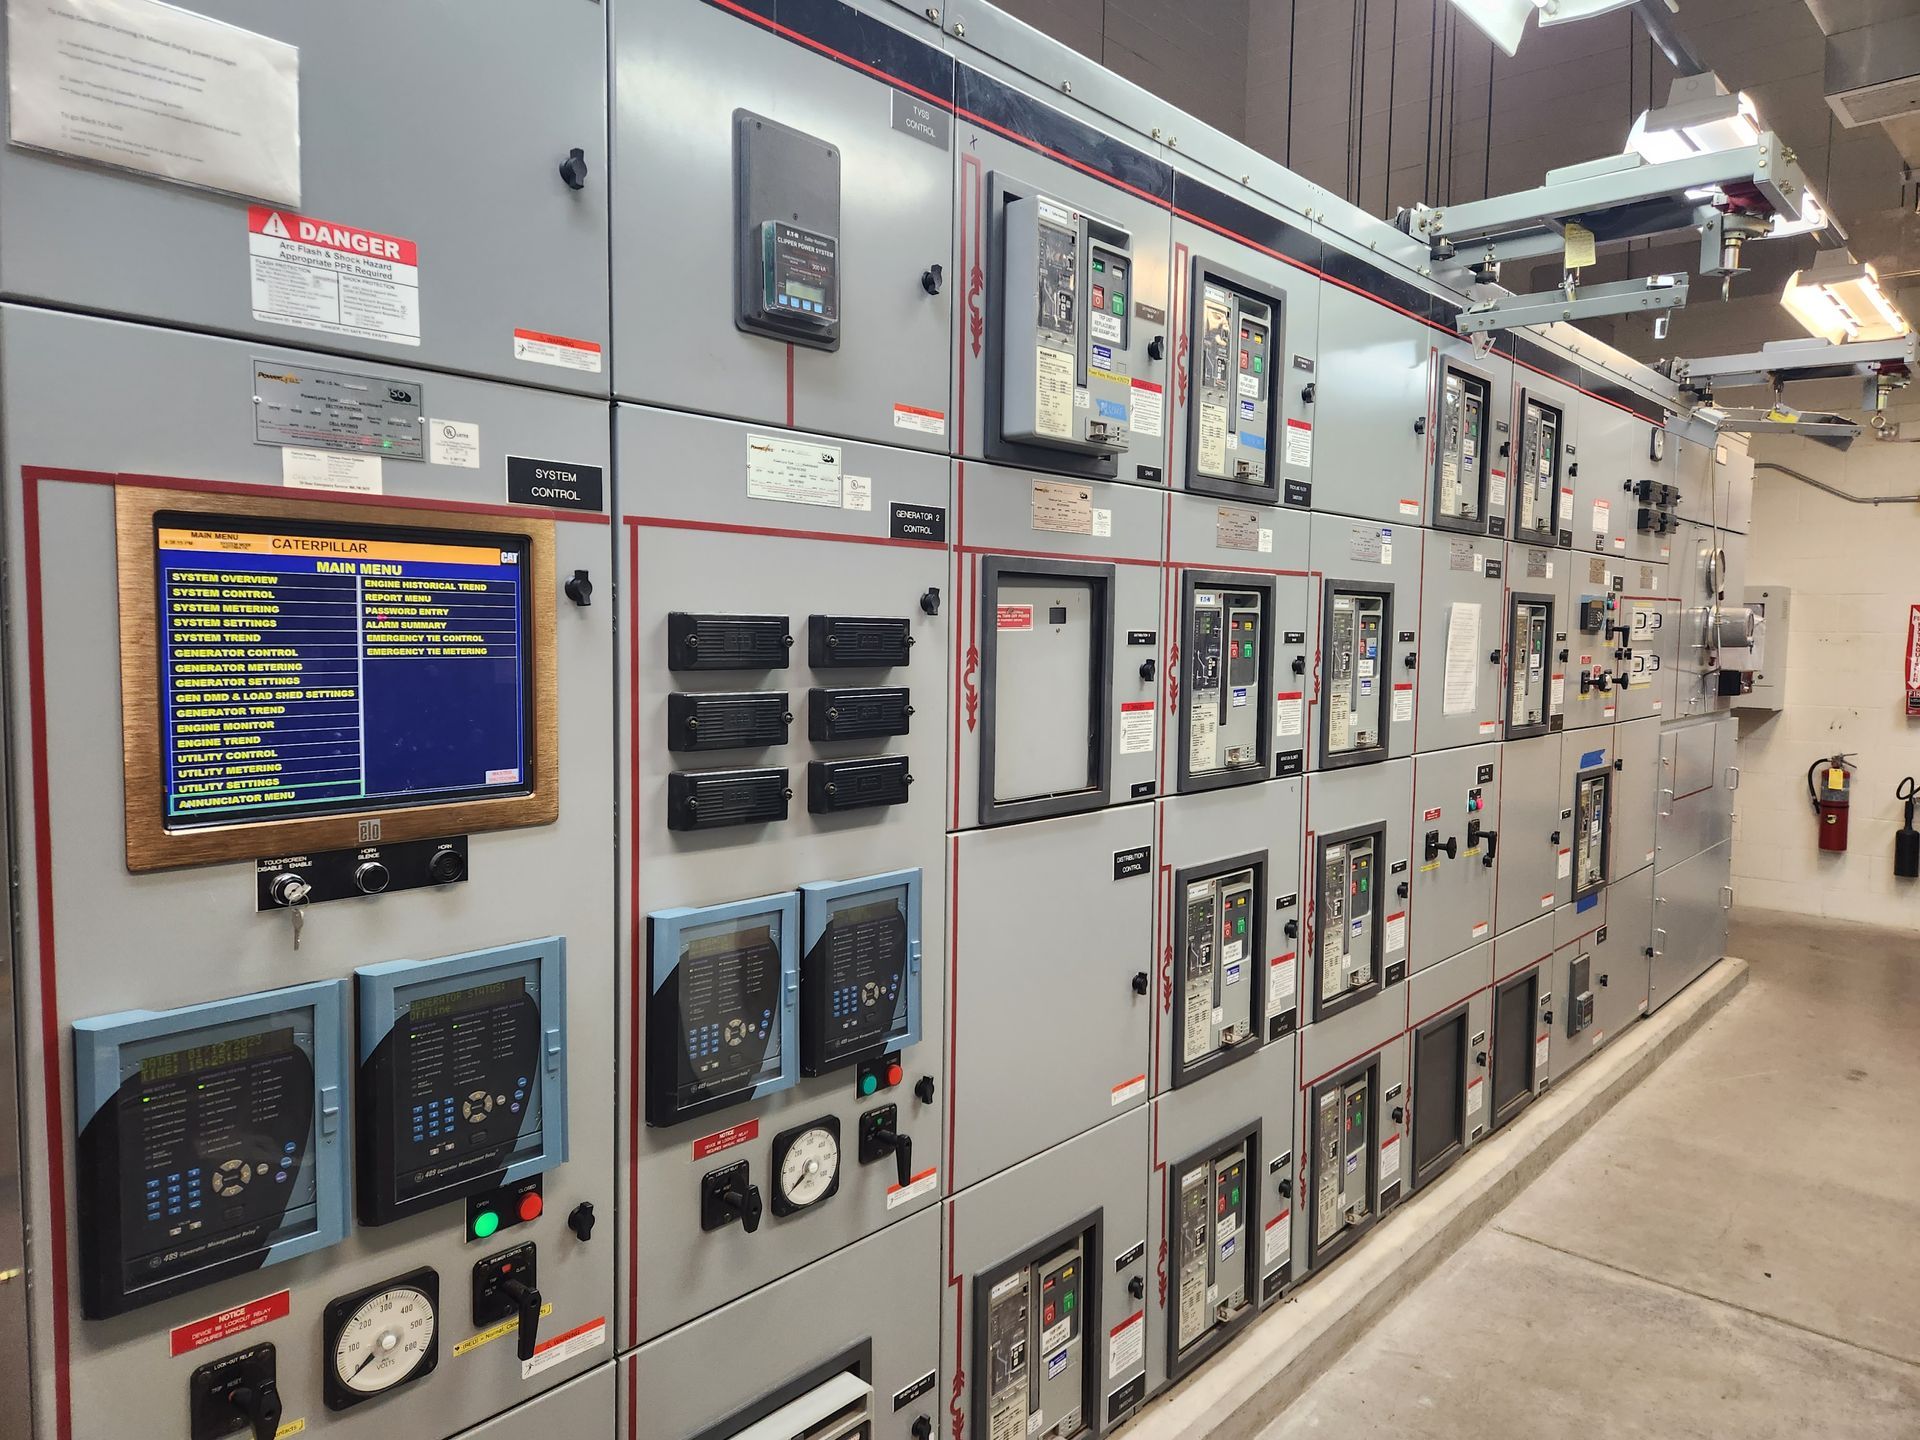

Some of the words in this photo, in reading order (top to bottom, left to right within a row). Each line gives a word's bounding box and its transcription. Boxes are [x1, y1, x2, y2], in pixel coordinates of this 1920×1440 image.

[912, 106, 930, 121] TVSS
[905, 118, 936, 138] CONTROL
[300, 221, 401, 260] DANGER
[777, 236, 797, 248] CLIPPER
[798, 242, 815, 253] POWER
[815, 247, 834, 258] SYSTEM
[280, 241, 295, 251] Arc
[297, 245, 322, 257] Flash
[324, 250, 331, 258] &
[334, 253, 360, 264] Shock
[363, 258, 392, 271] Hazard
[279, 251, 332, 268] Appropriate
[334, 262, 352, 272] PPE
[355, 265, 393, 280] Required
[535, 468, 577, 483] SYSTEM
[531, 486, 581, 501] CONTROL
[895, 510, 934, 521] GENERATOR
[191, 531, 212, 539] MAIN
[214, 533, 239, 541] MENU
[903, 525, 933, 535] CONTROL
[272, 538, 368, 554] CATERPILLAR
[500, 552, 518, 564] CAT
[316, 561, 356, 574] MAIN
[360, 563, 402, 576] MENU
[172, 573, 219, 583] SYSTEM
[220, 575, 278, 585] OVERVIEW
[364, 580, 400, 589] ENGINE
[402, 581, 456, 591] HISTORICAL
[458, 583, 487, 592] TREND
[172, 588, 220, 598] SYSTEM
[222, 590, 275, 599] CONTROL
[365, 594, 403, 602] REPORT
[404, 595, 432, 603] MENU
[172, 603, 220, 613] SYSTEM
[222, 604, 280, 614] METERING
[365, 607, 417, 616] PASSWORD
[419, 608, 449, 616] ENTRY
[173, 619, 221, 628] SYSTEM
[223, 619, 277, 628] SETTINGS
[366, 621, 399, 629] ALARM
[401, 621, 447, 630] SUMMARY
[174, 634, 221, 643] SYSTEM
[223, 633, 261, 642] TREND
[366, 634, 424, 643] EMERGENCY
[426, 634, 441, 642] TIE
[174, 649, 245, 658] GENERATOR
[247, 648, 299, 657] CONTROL
[367, 648, 425, 656] EMERGENCY
[443, 648, 487, 656] METERING
[175, 663, 245, 673] GENERATOR
[247, 662, 303, 672] METERING
[175, 678, 245, 688] GENERATOR
[247, 677, 300, 686] SETTINGS
[176, 694, 200, 703] GEN
[203, 693, 230, 702] DMD
[232, 692, 241, 701] &
[243, 692, 273, 701] LOAD
[275, 691, 303, 700] SHED
[305, 689, 355, 699] SETTINGS
[176, 707, 246, 718] GENERATOR
[249, 706, 285, 715] TREND
[176, 723, 221, 733] ENGINE
[223, 721, 275, 731] MONITOR
[177, 738, 221, 748] ENGINE
[223, 736, 261, 746] TREND
[177, 753, 223, 763] UTILITY
[225, 749, 278, 760] CONTROL
[178, 768, 224, 778] UTILITY
[226, 764, 282, 775] METERING
[178, 782, 224, 793] UTILITY
[226, 778, 280, 789] SETTINGS
[179, 794, 262, 809] ANNUNCIATOR
[264, 791, 295, 801] MENU
[264, 856, 307, 866] TOUCHSCREEN
[357, 852, 380, 860] SILENCE
[1116, 852, 1144, 864] DISTRIBUTION
[257, 864, 283, 873] DISABLE
[289, 860, 313, 869] ENABLE
[1122, 864, 1142, 873] CONTROL
[518, 1183, 537, 1194] CLOSED
[475, 1200, 490, 1209] OPEN
[163, 1251, 179, 1263] 489
[206, 1232, 242, 1248] Management
[241, 1227, 257, 1239] Relay
[379, 1302, 393, 1313] 300
[400, 1304, 414, 1315] 400
[218, 1308, 246, 1324] NOTICE
[191, 1329, 213, 1341] DEVICE
[224, 1315, 251, 1329] LOCKOUT
[253, 1307, 272, 1320] RELAY
[358, 1319, 372, 1331] 200
[410, 1318, 423, 1330] 500
[195, 1332, 223, 1346] REQUIRES
[225, 1324, 249, 1337] MANUAL
[250, 1315, 269, 1327] RESET
[348, 1341, 360, 1352] 100
[404, 1341, 418, 1352] 600
[213, 1358, 239, 1371] LOCK-OUT
[239, 1351, 255, 1361] RELAY
[376, 1359, 396, 1371] VOLTS
